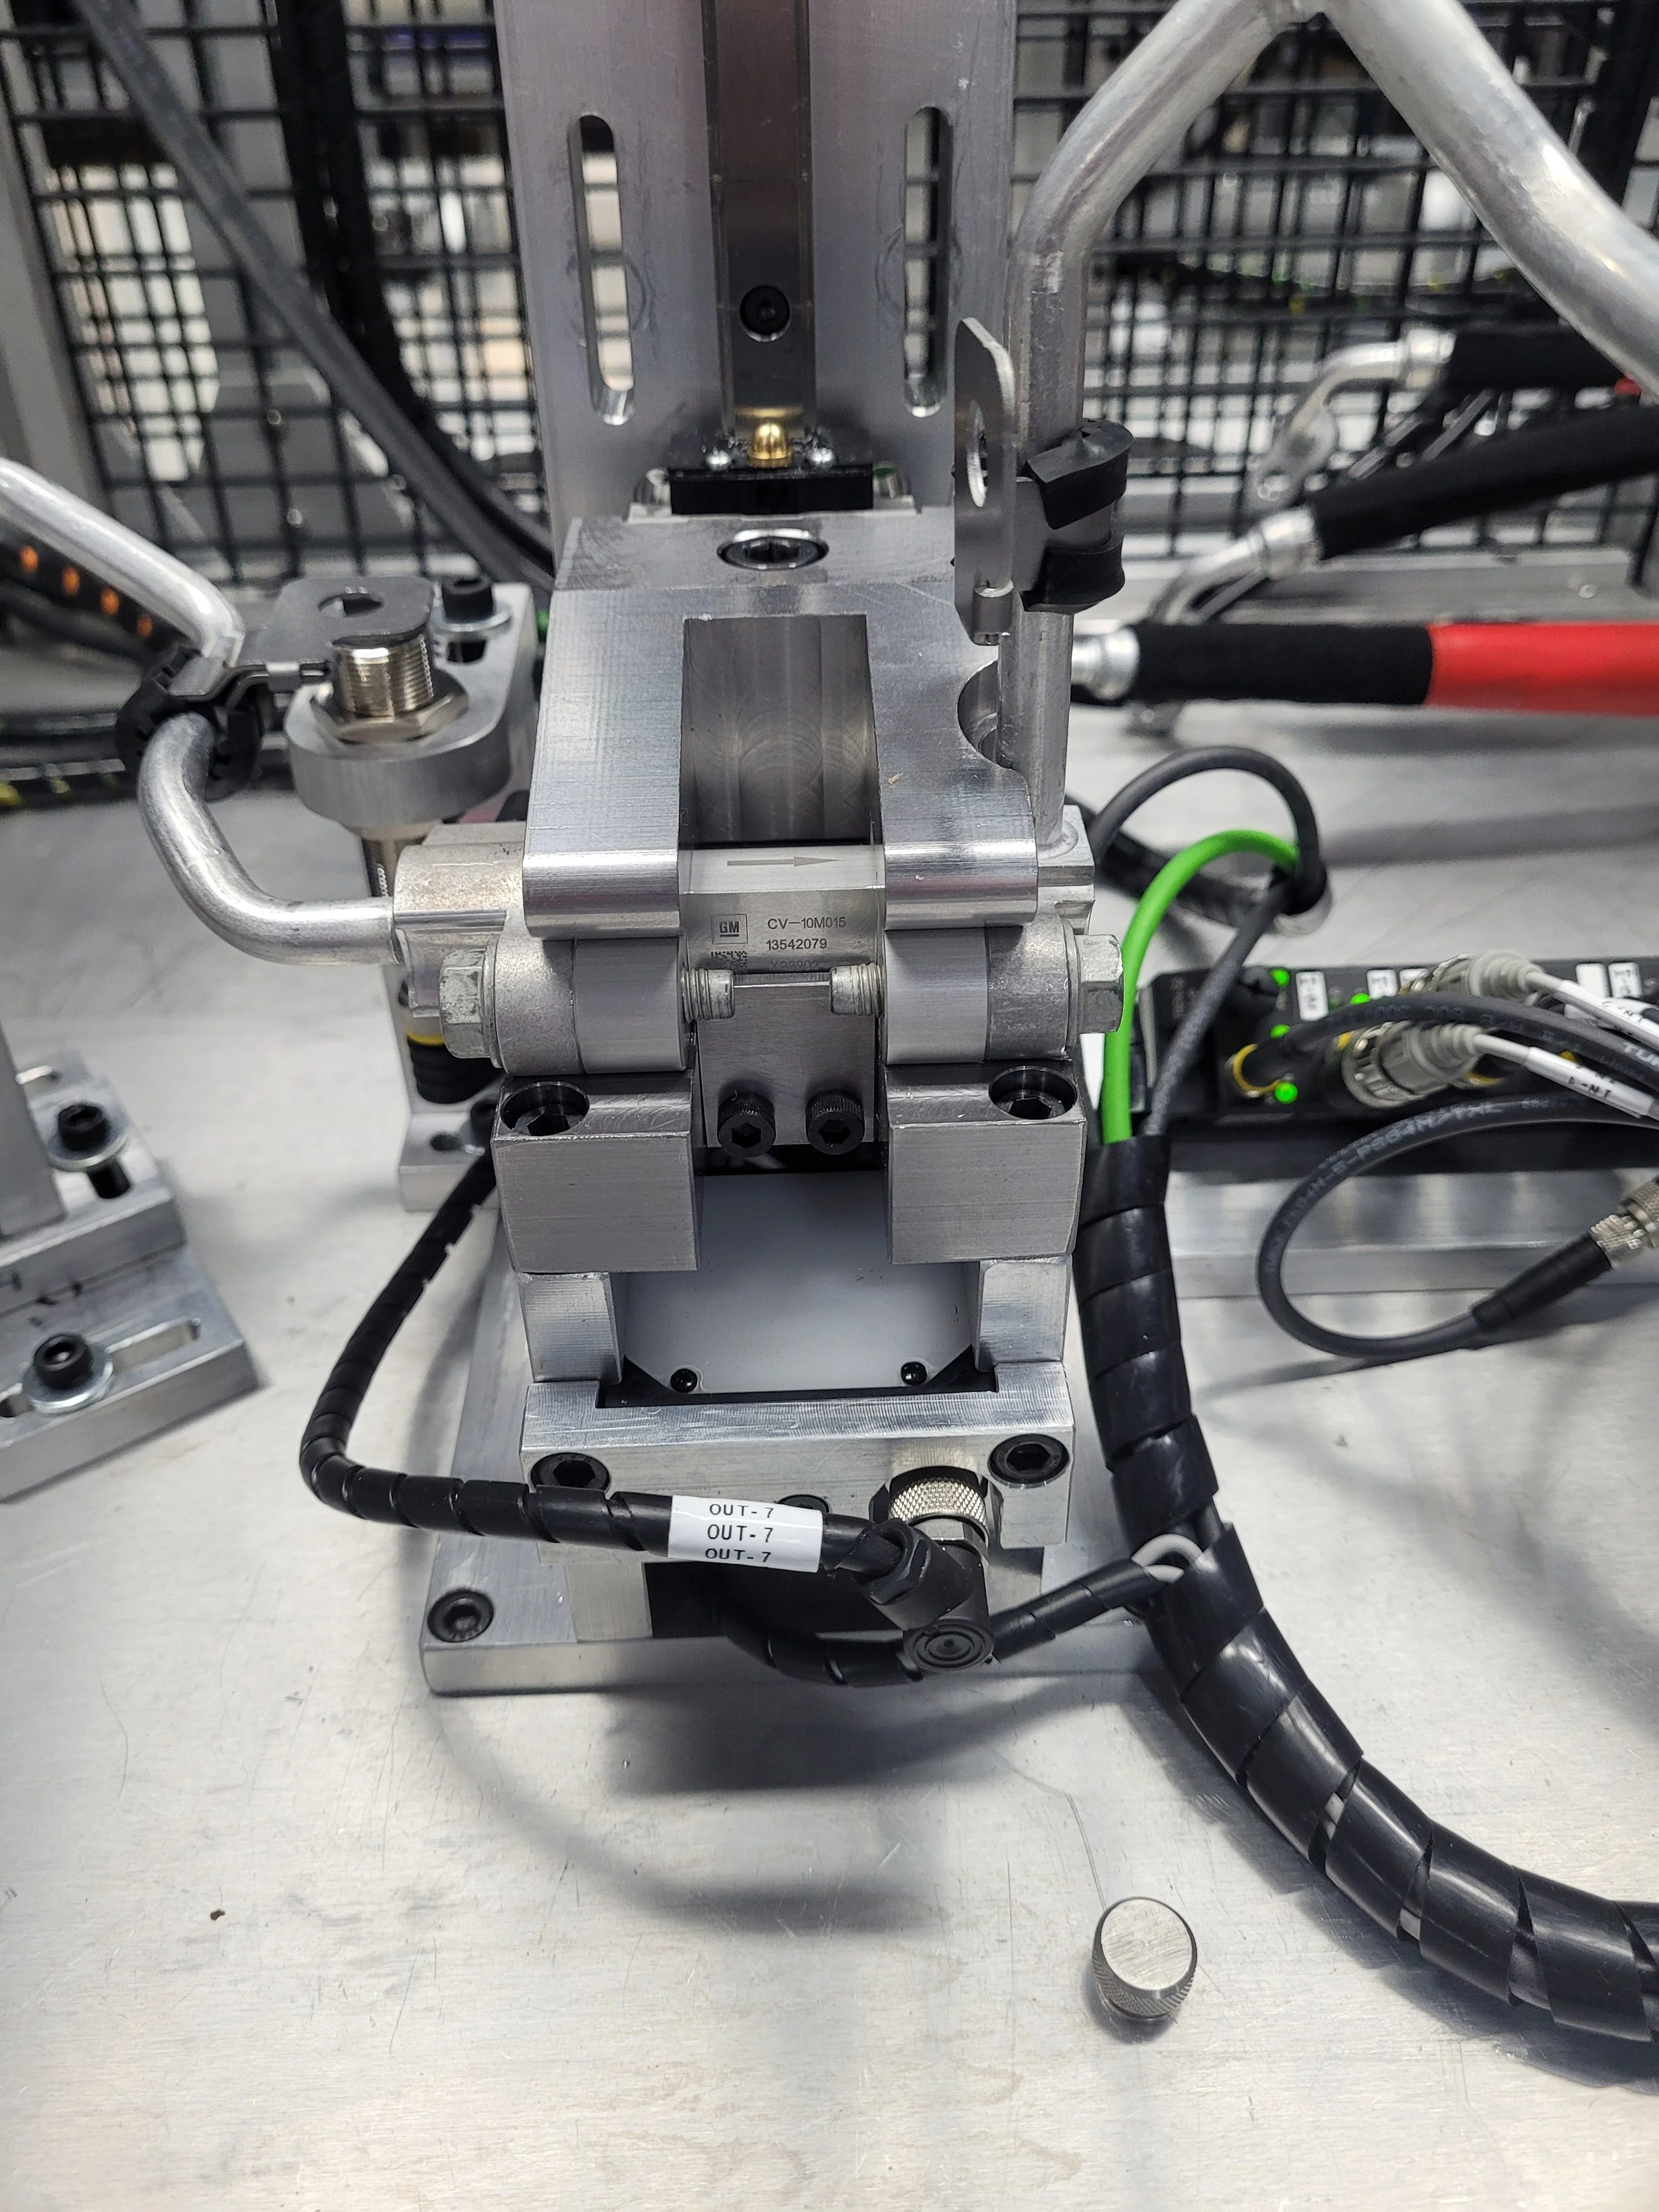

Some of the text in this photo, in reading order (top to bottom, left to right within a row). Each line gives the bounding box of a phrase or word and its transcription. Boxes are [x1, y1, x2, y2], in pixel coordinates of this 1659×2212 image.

[719, 921, 740, 934] GM
[767, 917, 847, 930] CV-10M015
[765, 938, 828, 950] 13542079
[709, 1503, 774, 1518] OUT-7
[707, 1524, 774, 1543] OUT-7
[705, 1548, 772, 1563] OUT-7
